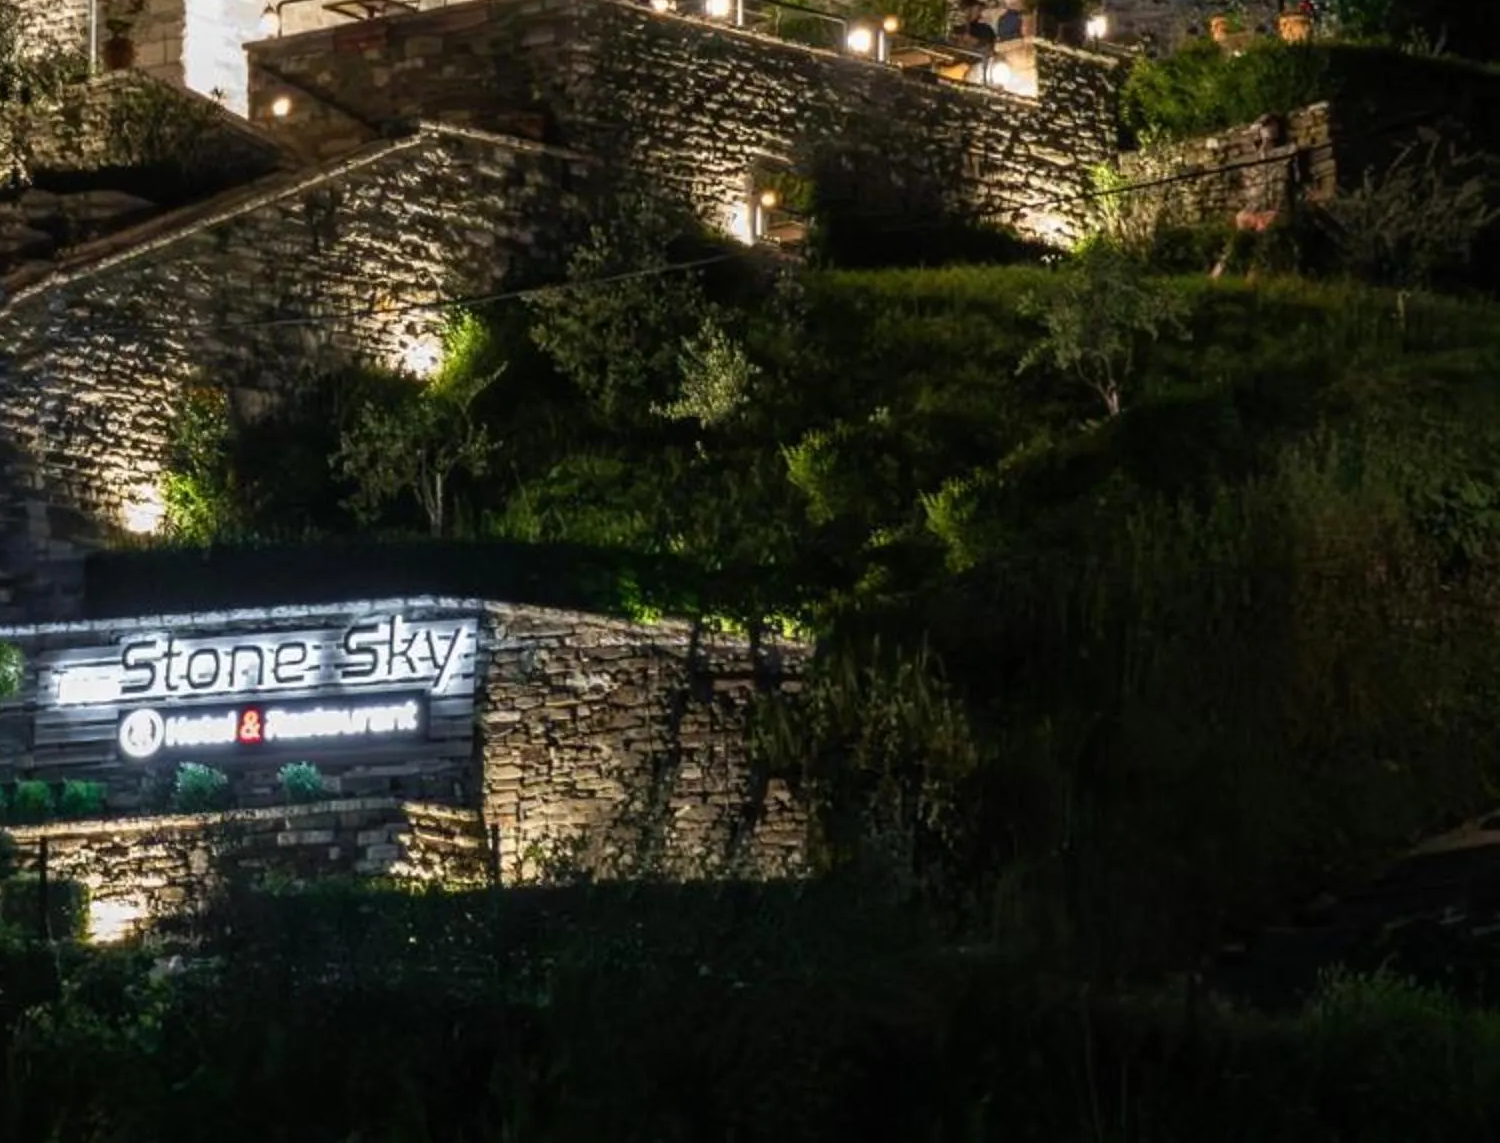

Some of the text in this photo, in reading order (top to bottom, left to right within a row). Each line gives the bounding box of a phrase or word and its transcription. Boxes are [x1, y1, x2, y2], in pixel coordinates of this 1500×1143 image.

[120, 614, 468, 694] Stone Sky
[240, 708, 261, 742] &
